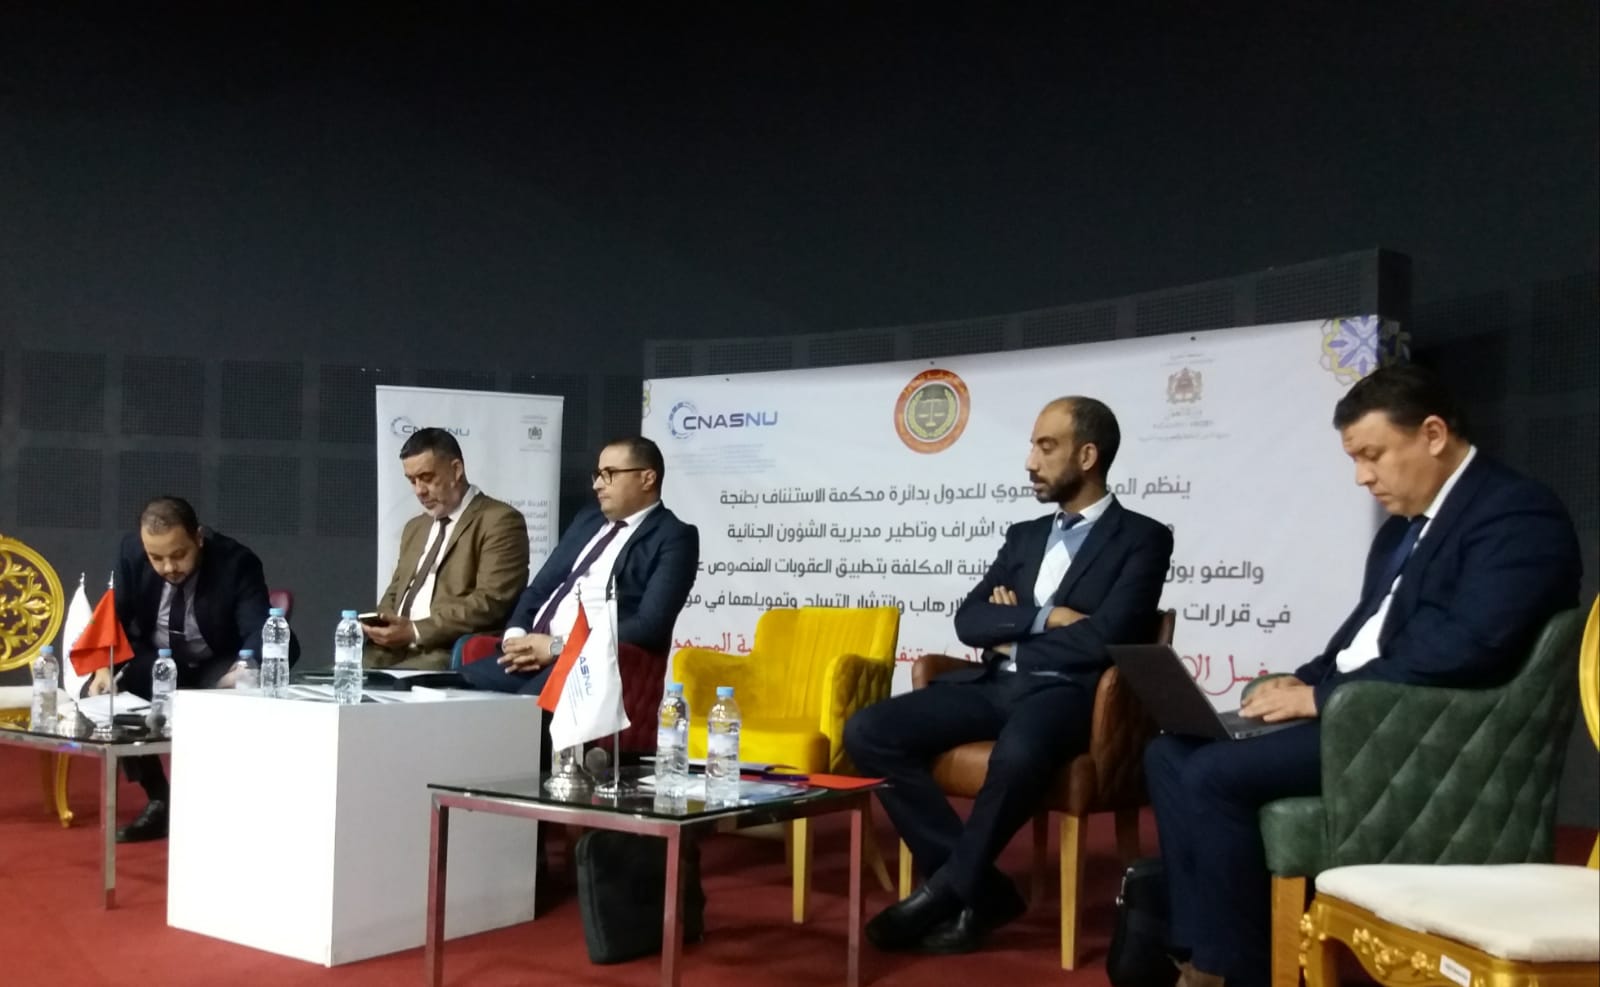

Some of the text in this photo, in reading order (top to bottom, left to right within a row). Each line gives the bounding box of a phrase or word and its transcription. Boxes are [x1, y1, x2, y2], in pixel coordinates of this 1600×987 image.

[683, 411, 778, 430] CNASNU
[402, 425, 470, 437] CNNU
[762, 487, 826, 504] الاستئناف
[828, 486, 885, 502] محكمة
[888, 484, 930, 505] بدائرة
[933, 483, 987, 504] للعدول
[1142, 475, 1190, 499] ينظم
[719, 489, 759, 509] بطنجة
[727, 523, 774, 543] الجنائية
[776, 519, 827, 542] الشؤون
[830, 523, 882, 543] مديرية
[708, 557, 772, 576] المنصوص
[775, 557, 832, 578] العقوبات
[835, 557, 887, 580] بتطبيق
[891, 558, 952, 575] المكلفة
[1200, 560, 1265, 585] والعفو
[704, 590, 725, 612] في
[728, 591, 798, 611] وتمويلهما
[1183, 603, 1251, 627] قرارات
[1256, 604, 1291, 633] في
